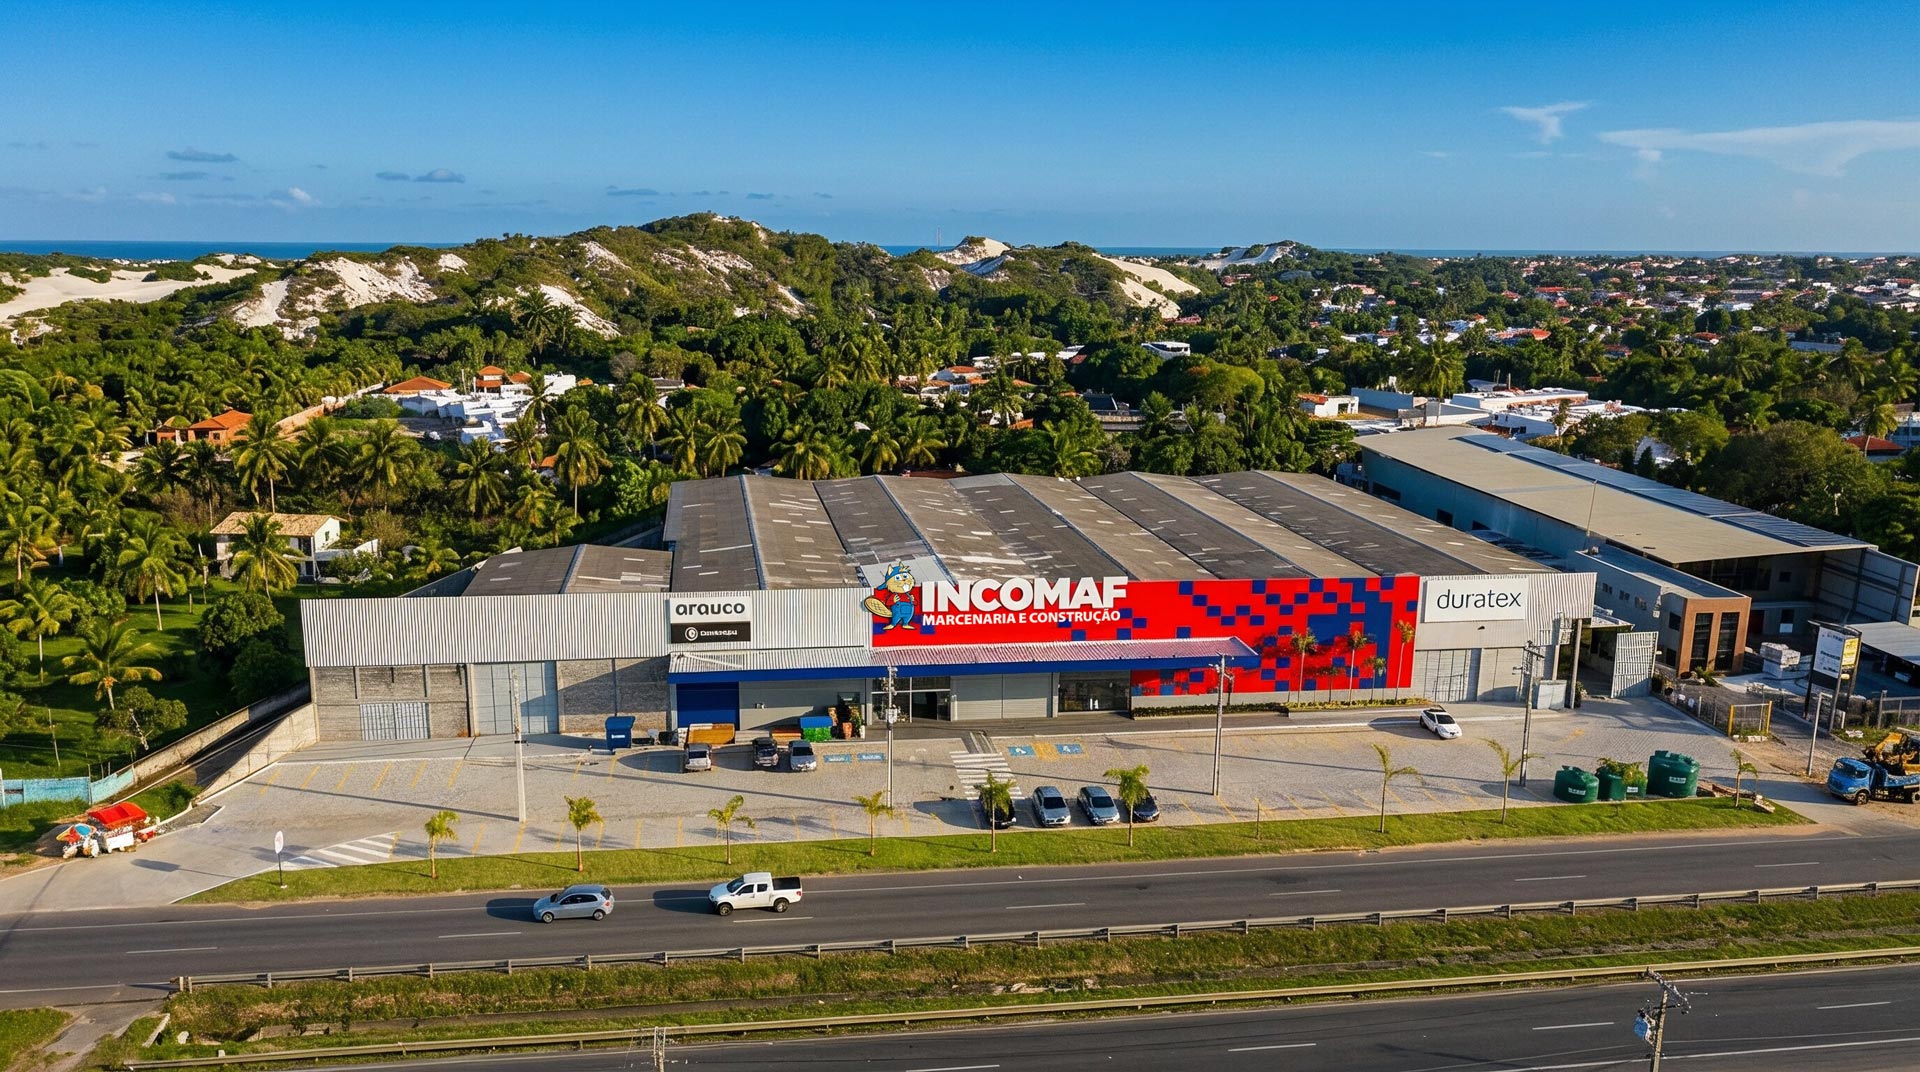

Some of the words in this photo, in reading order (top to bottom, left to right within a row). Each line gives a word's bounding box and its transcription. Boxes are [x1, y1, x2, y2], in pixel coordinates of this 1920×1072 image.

[921, 576, 1129, 612] INCOMAF
[1436, 588, 1522, 609] duratex
[675, 603, 746, 616] arauco
[922, 612, 1017, 626] MARCENARIA
[1019, 612, 1027, 624] E
[1029, 608, 1121, 625] CONSTRUÇÃO
